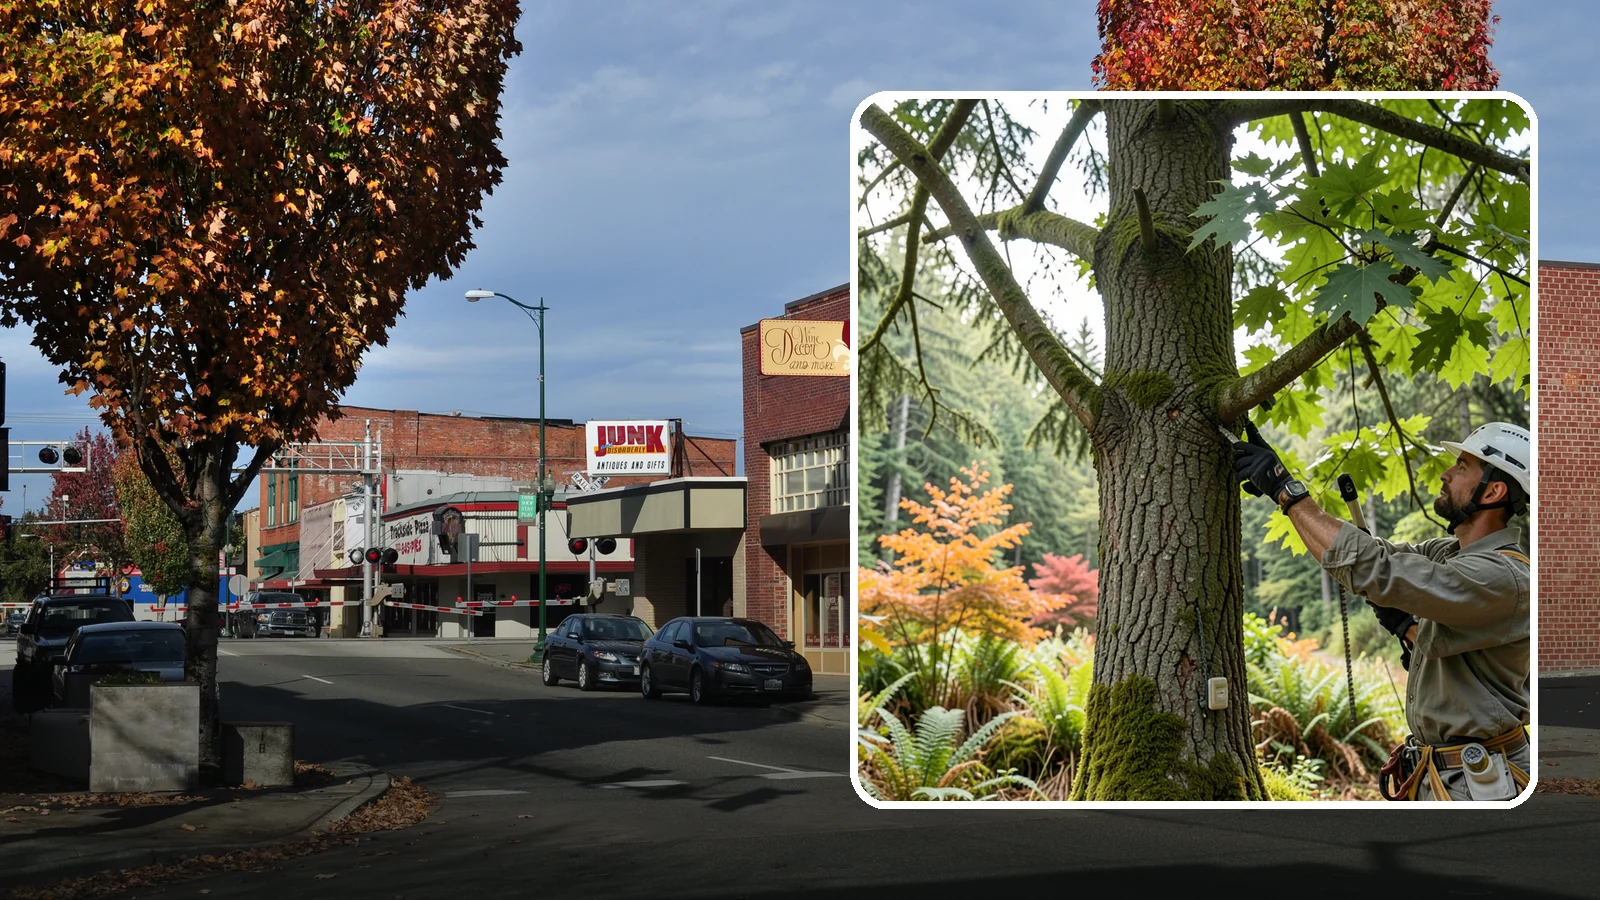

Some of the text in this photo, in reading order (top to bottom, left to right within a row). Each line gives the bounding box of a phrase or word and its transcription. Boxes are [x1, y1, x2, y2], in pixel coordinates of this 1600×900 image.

[596, 425, 665, 457] JUNK
[607, 446, 645, 454] DISORDERLY
[597, 460, 665, 470] ANTIQUES AND GIFTS
[414, 519, 429, 535] Pizza
